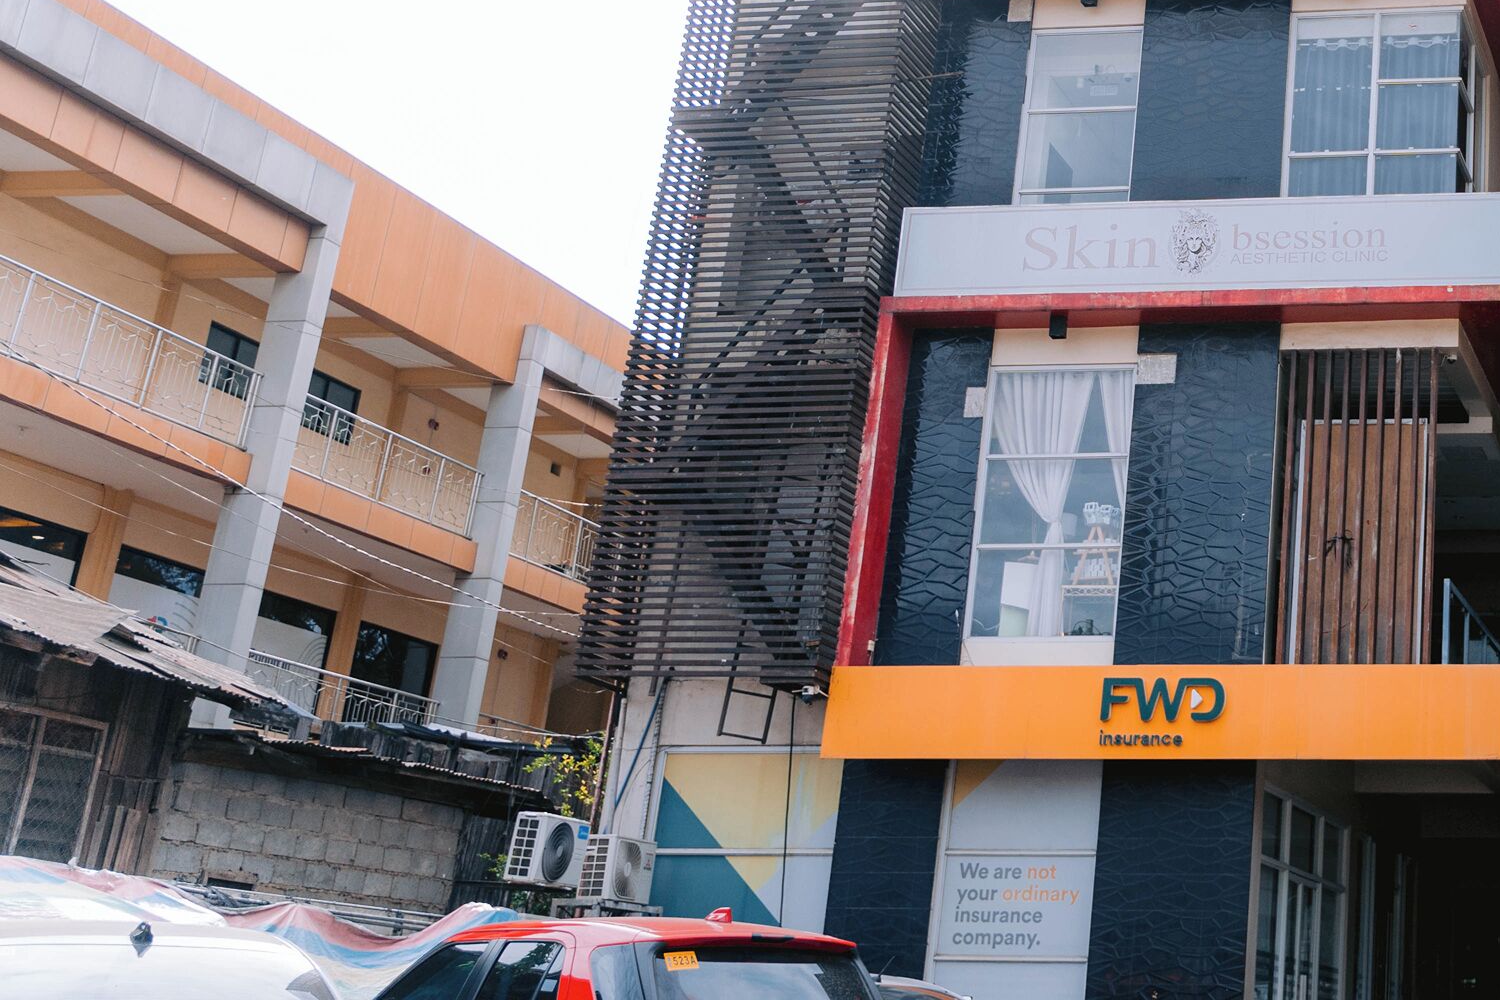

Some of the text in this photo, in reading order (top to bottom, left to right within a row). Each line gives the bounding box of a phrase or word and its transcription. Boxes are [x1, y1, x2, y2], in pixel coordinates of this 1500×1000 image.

[1022, 224, 1160, 272] Skin
[1230, 249, 1389, 265] AESTHETIC CLINIC
[1099, 677, 1227, 723] FWD
[1099, 729, 1184, 746] insurance
[960, 862, 1057, 880] We are not
[956, 884, 1080, 904] your ordinary
[954, 905, 1043, 923] insurance
[952, 932, 1041, 949] company.
